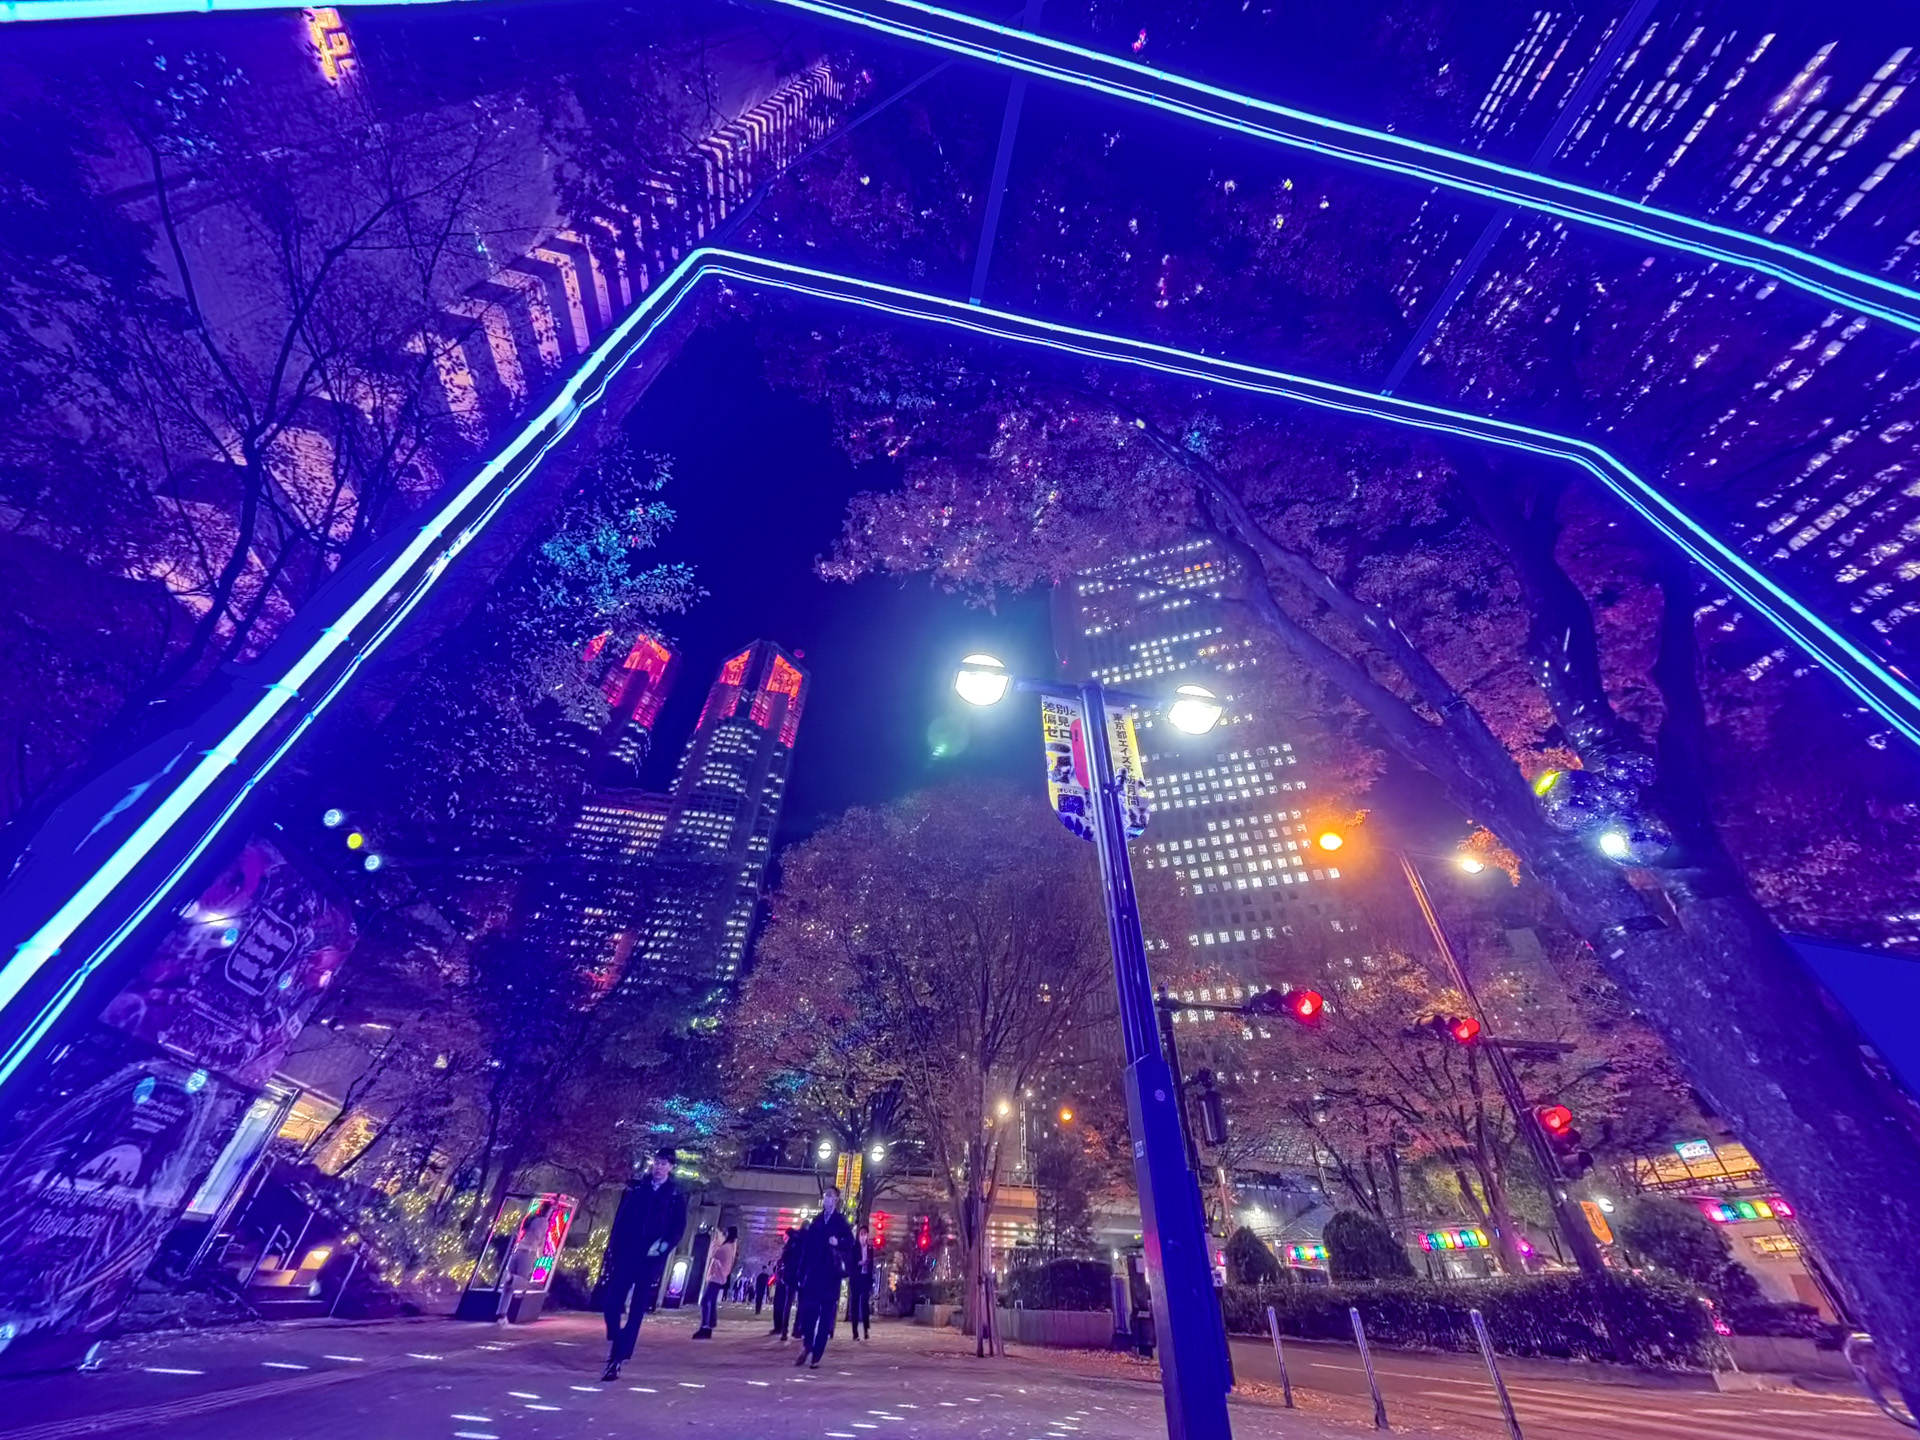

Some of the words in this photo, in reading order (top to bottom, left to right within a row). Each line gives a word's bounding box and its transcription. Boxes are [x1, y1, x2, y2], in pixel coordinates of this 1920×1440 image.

[1043, 701, 1077, 717] 差別と
[1044, 713, 1070, 727] 偏見
[37, 1173, 84, 1208] Happy
[29, 1208, 75, 1239] Tokyo
